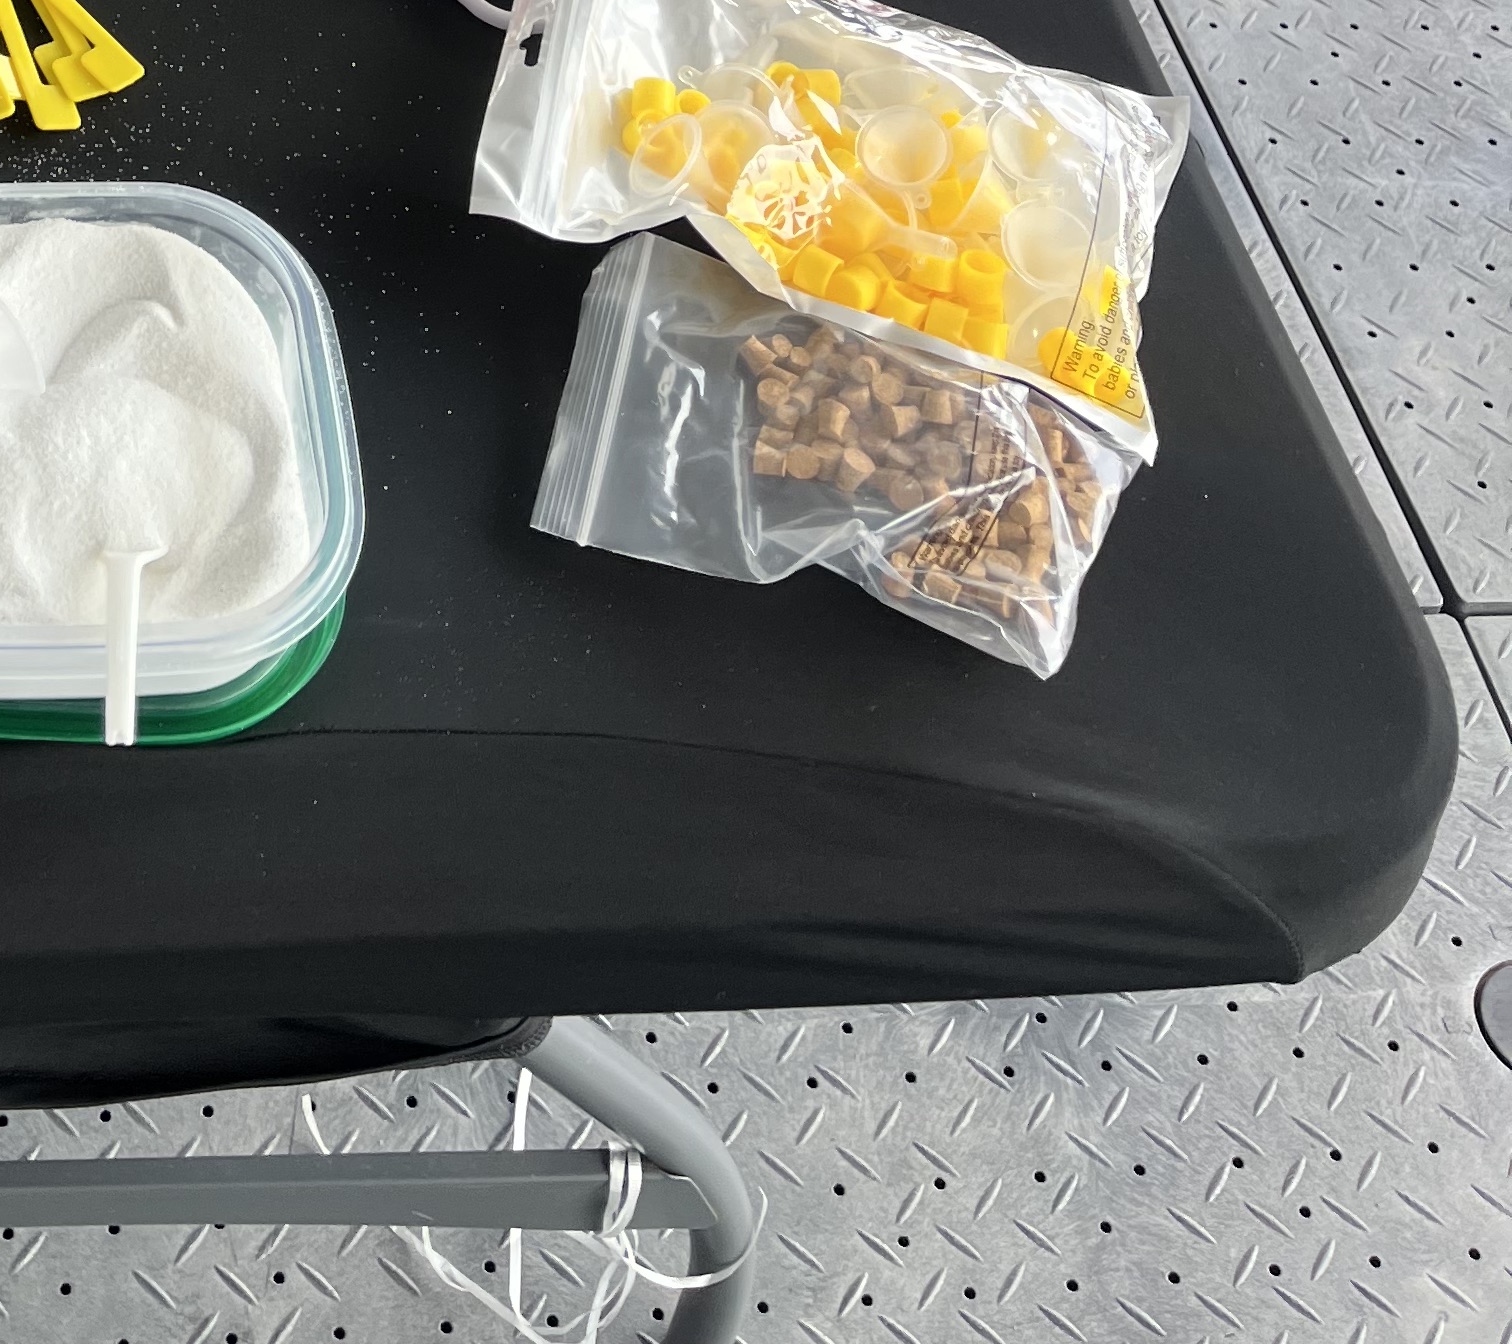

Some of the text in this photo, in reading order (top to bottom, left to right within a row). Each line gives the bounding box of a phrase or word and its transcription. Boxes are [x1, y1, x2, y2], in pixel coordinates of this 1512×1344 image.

[1062, 320, 1095, 373] Warning
[1082, 363, 1100, 380] To
[1097, 325, 1112, 362] avoid
[1104, 347, 1128, 391] babies
[1124, 383, 1136, 400] or
